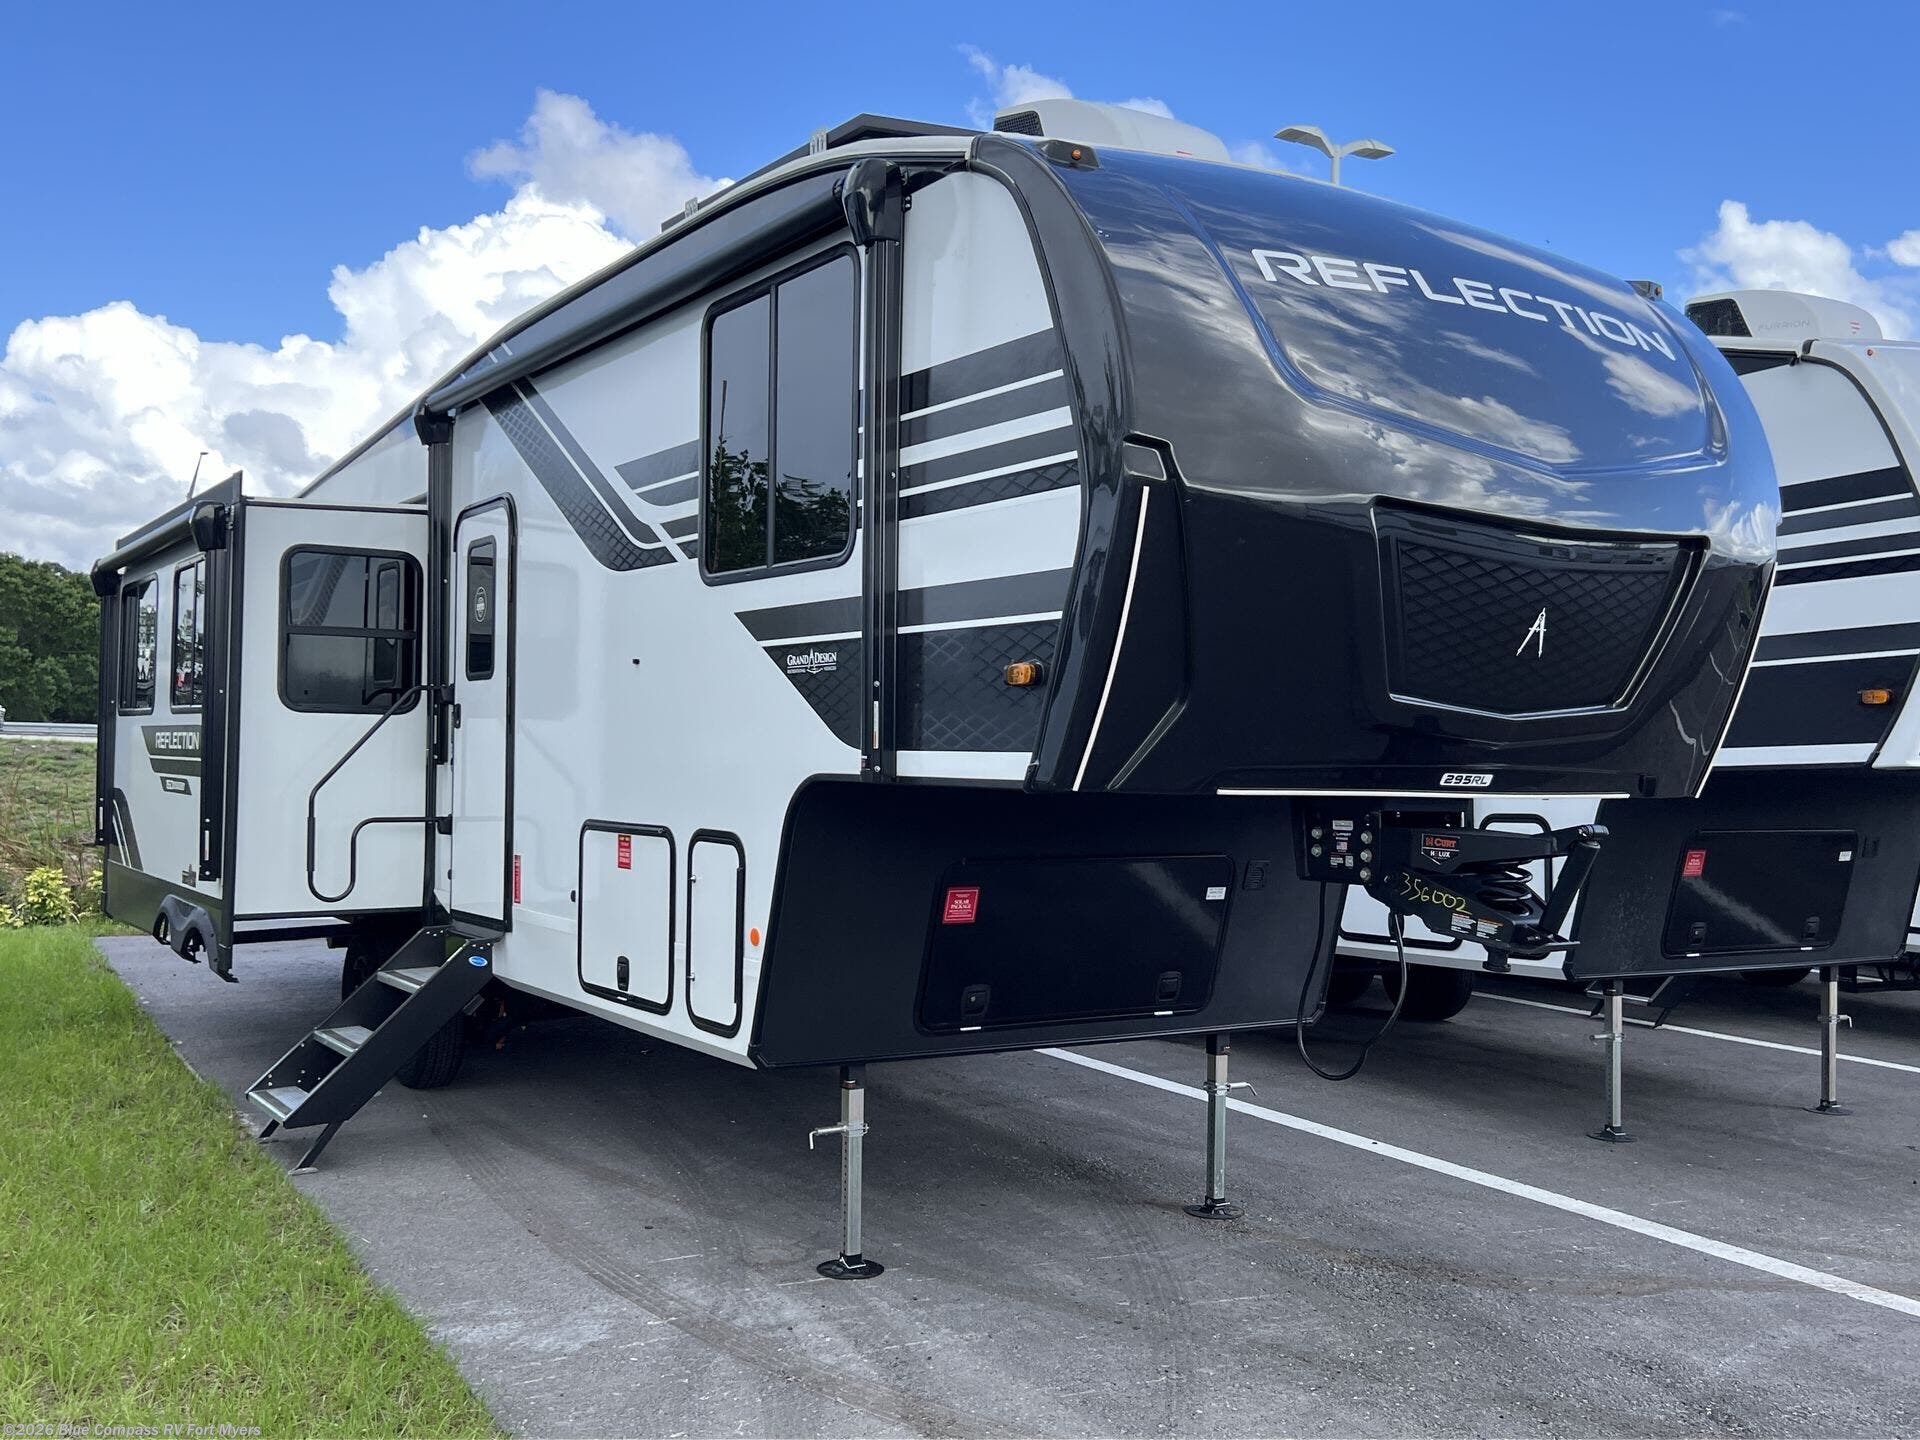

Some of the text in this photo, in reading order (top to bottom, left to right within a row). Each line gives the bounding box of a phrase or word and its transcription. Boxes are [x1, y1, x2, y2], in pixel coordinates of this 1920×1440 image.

[1251, 248, 1676, 361] REFLECTION
[787, 652, 837, 666] GRAND DESIGN
[155, 731, 200, 750] REFLECTION
[1443, 774, 1489, 785] 295RL
[1434, 837, 1457, 848] CURT
[1400, 872, 1473, 915] 356002
